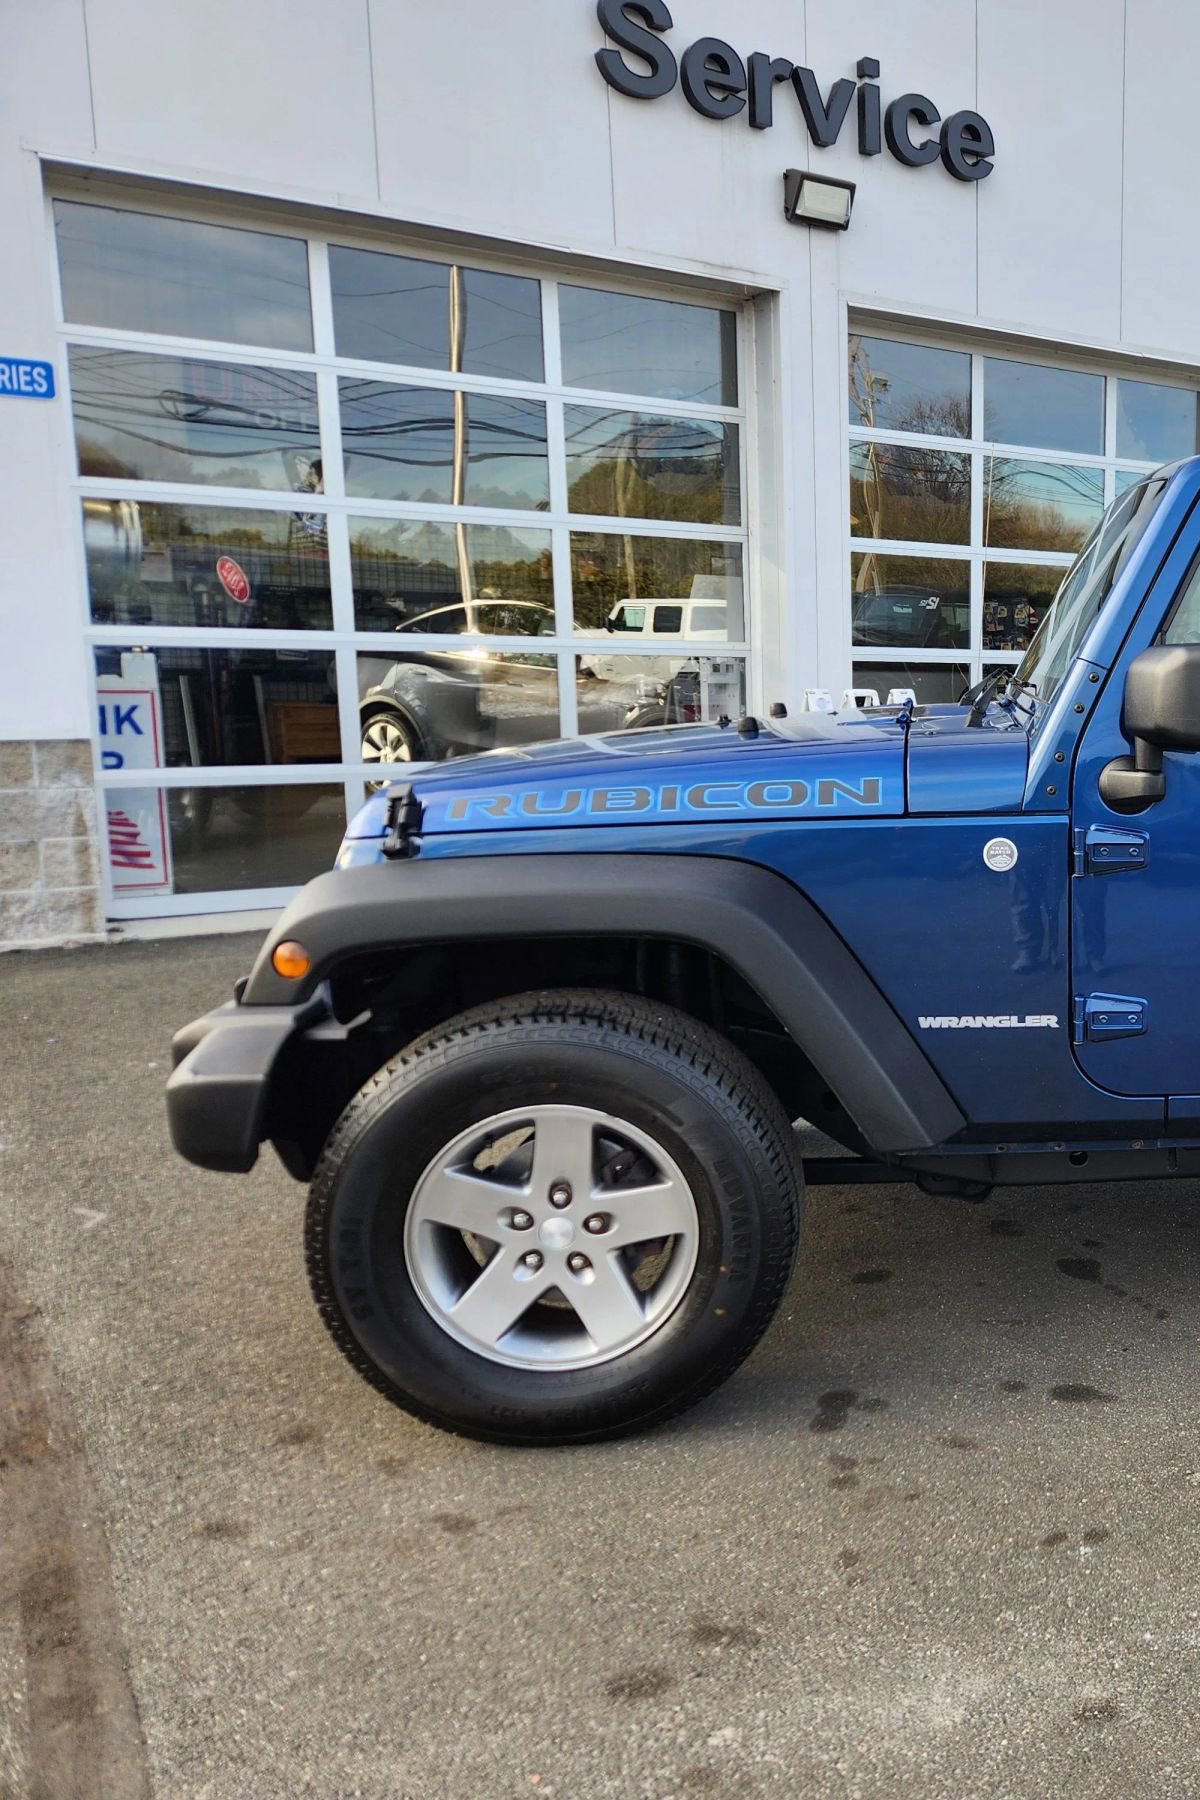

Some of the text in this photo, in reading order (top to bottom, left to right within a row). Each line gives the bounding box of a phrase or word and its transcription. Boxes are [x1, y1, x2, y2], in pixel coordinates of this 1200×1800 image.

[594, 0, 995, 182] Service
[446, 777, 883, 821] RUBICON
[918, 1015, 1059, 1029] WRANGLER
